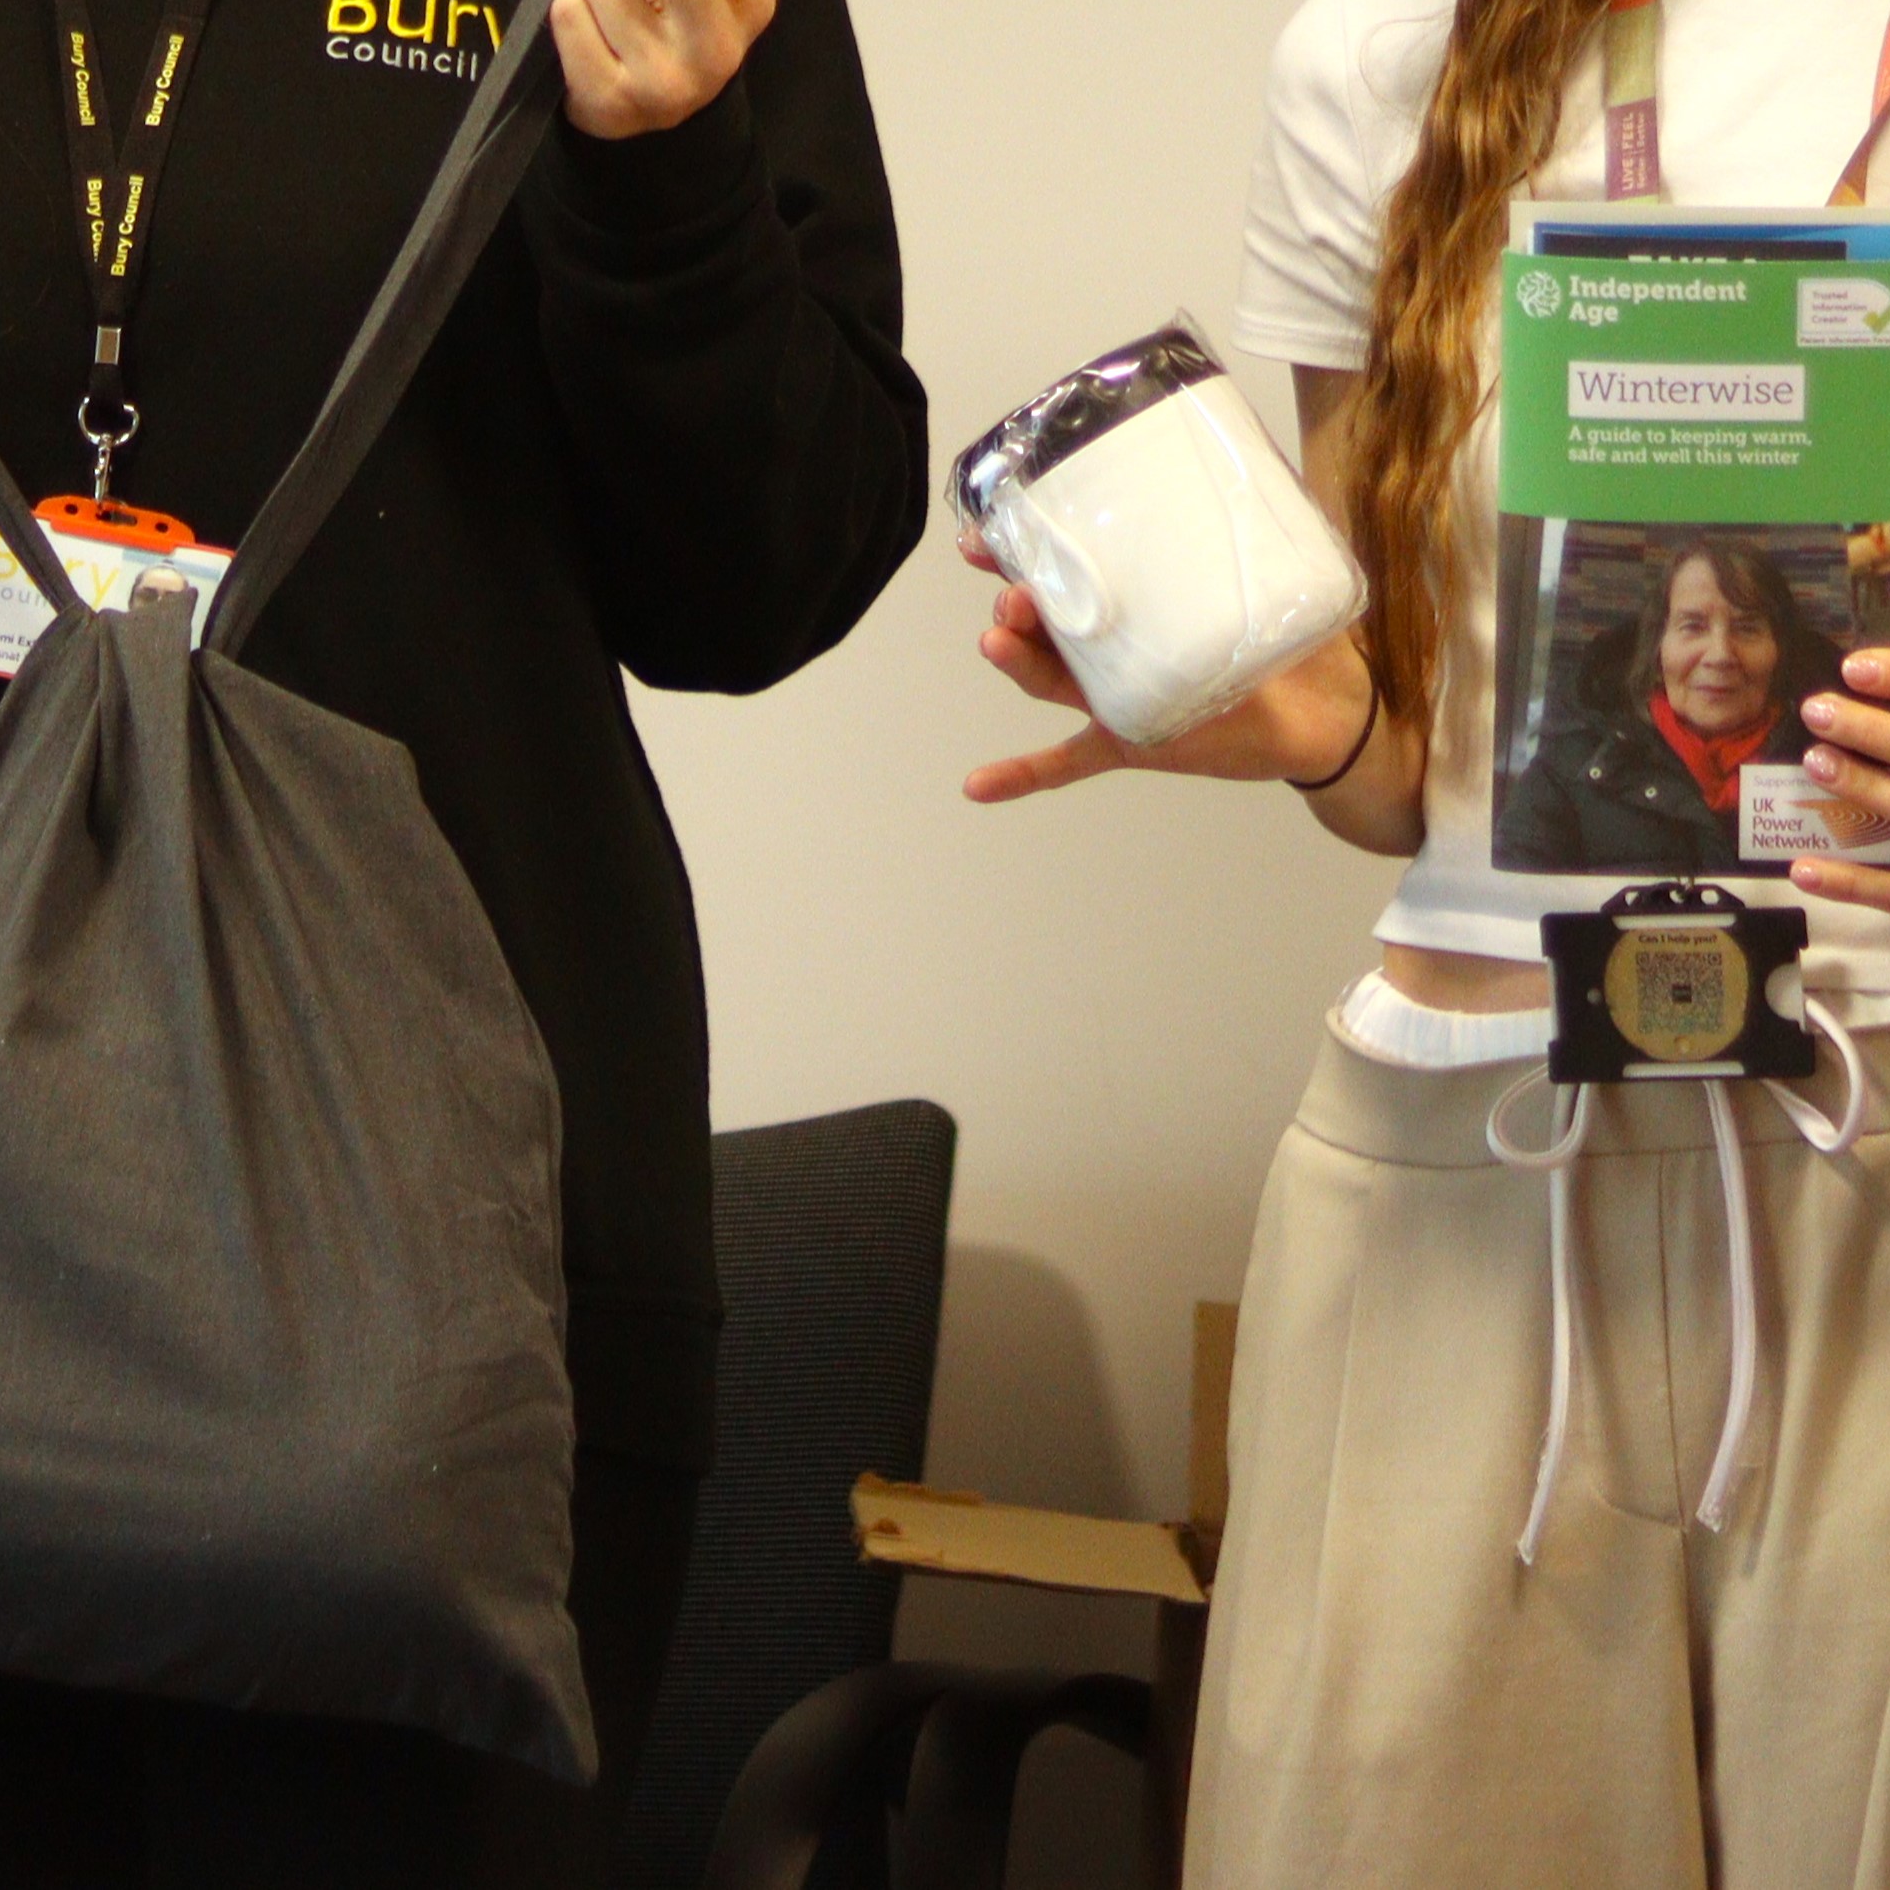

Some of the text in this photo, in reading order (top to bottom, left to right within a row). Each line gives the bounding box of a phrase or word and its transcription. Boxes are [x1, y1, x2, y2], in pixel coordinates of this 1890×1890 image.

[326, 35, 478, 82] Council
[70, 30, 96, 126] Bury Council
[145, 34, 185, 126] Bury Council
[1621, 112, 1634, 191] LIVE FEEL
[86, 178, 103, 217] Bury
[110, 175, 145, 277] Bury Council
[1568, 274, 1747, 305] Independent
[1568, 301, 1620, 327] Age
[1576, 371, 1794, 405] Winterwise
[1568, 425, 1813, 448] A guide to keeping warm,
[1568, 446, 1800, 465] safe and well this winter
[17, 635, 35, 647] Ex
[1753, 775, 1809, 787] Supporte
[1752, 797, 1775, 813] UK
[1752, 816, 1804, 831] Power
[1752, 832, 1830, 849] Networks
[1638, 934, 1659, 943] Can
[1667, 934, 1690, 945] help
[1692, 934, 1718, 946] you?
